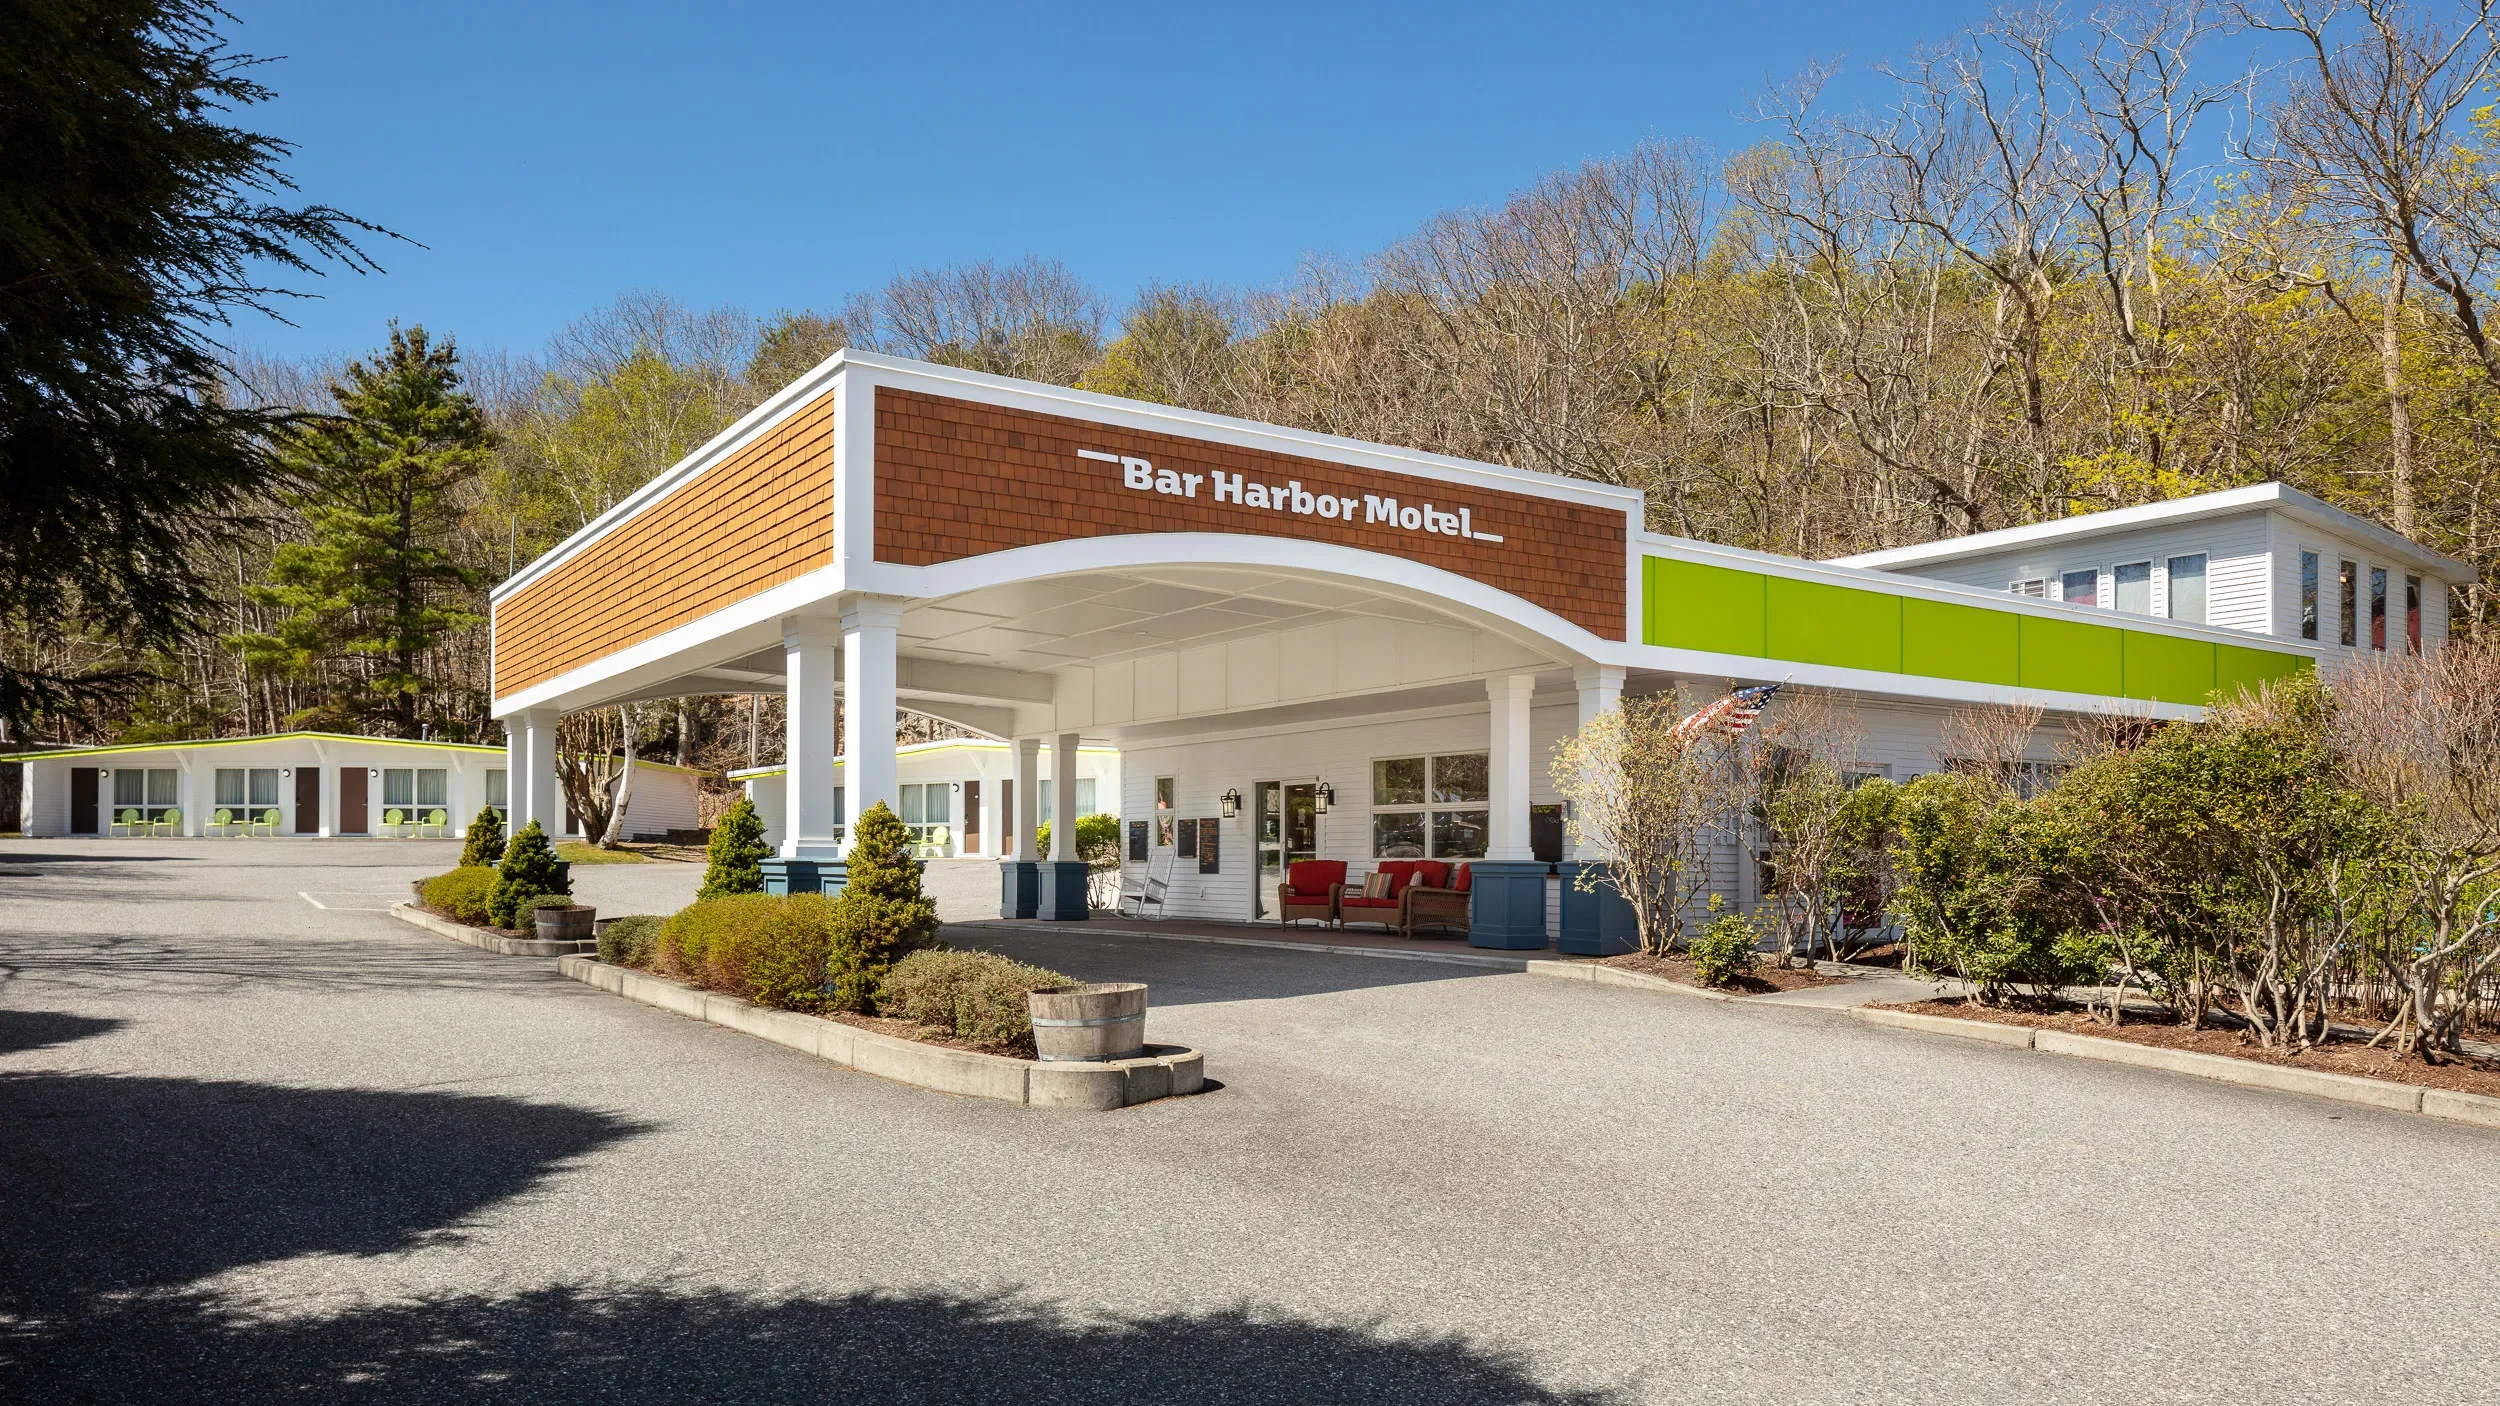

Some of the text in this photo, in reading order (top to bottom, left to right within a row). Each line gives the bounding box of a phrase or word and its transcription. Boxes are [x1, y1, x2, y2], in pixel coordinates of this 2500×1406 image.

[1120, 456, 1472, 538] Bar Harbor Motel
